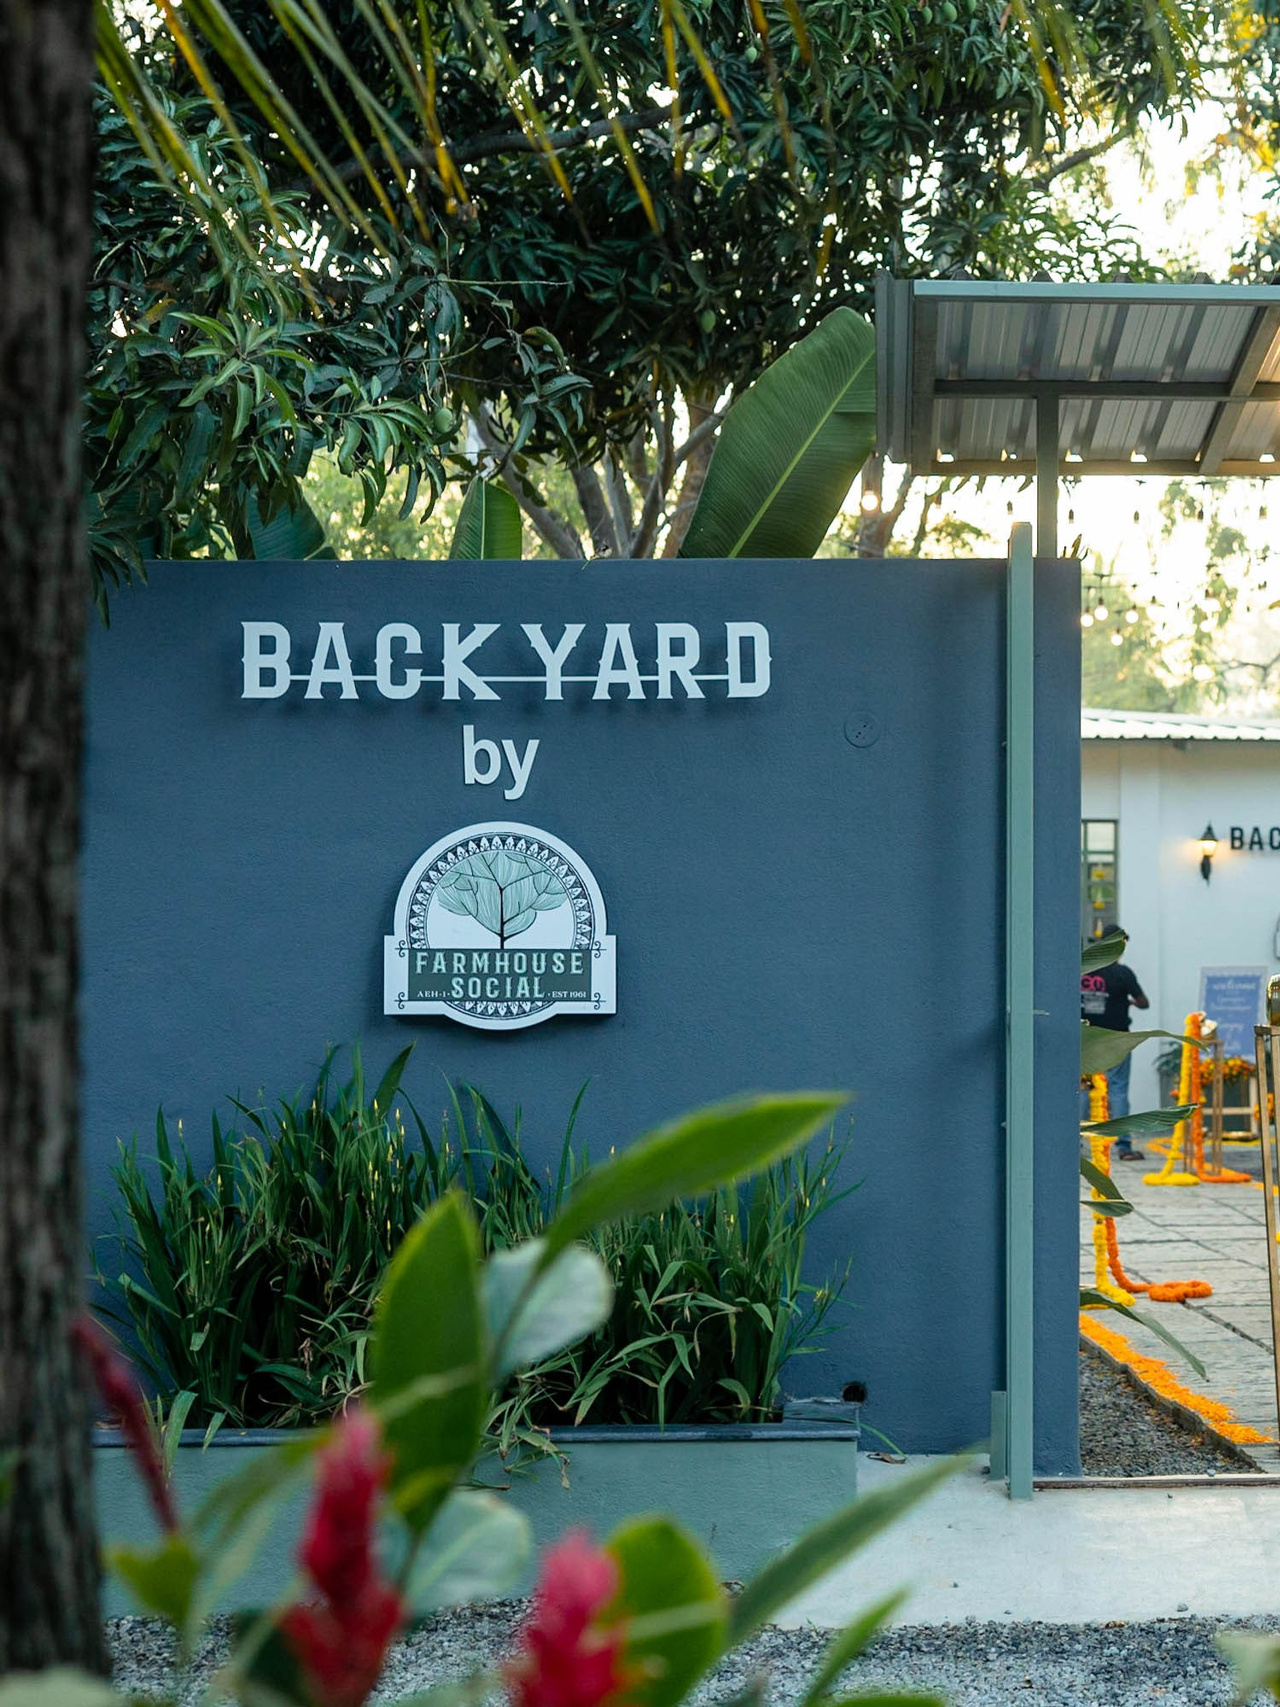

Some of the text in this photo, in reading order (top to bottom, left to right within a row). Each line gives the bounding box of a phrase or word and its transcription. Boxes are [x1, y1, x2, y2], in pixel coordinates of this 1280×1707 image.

[241, 621, 772, 700] BACKYARD
[462, 725, 539, 800] by
[415, 952, 584, 974] FARMHOUSE
[451, 976, 545, 999] SOCIAL
